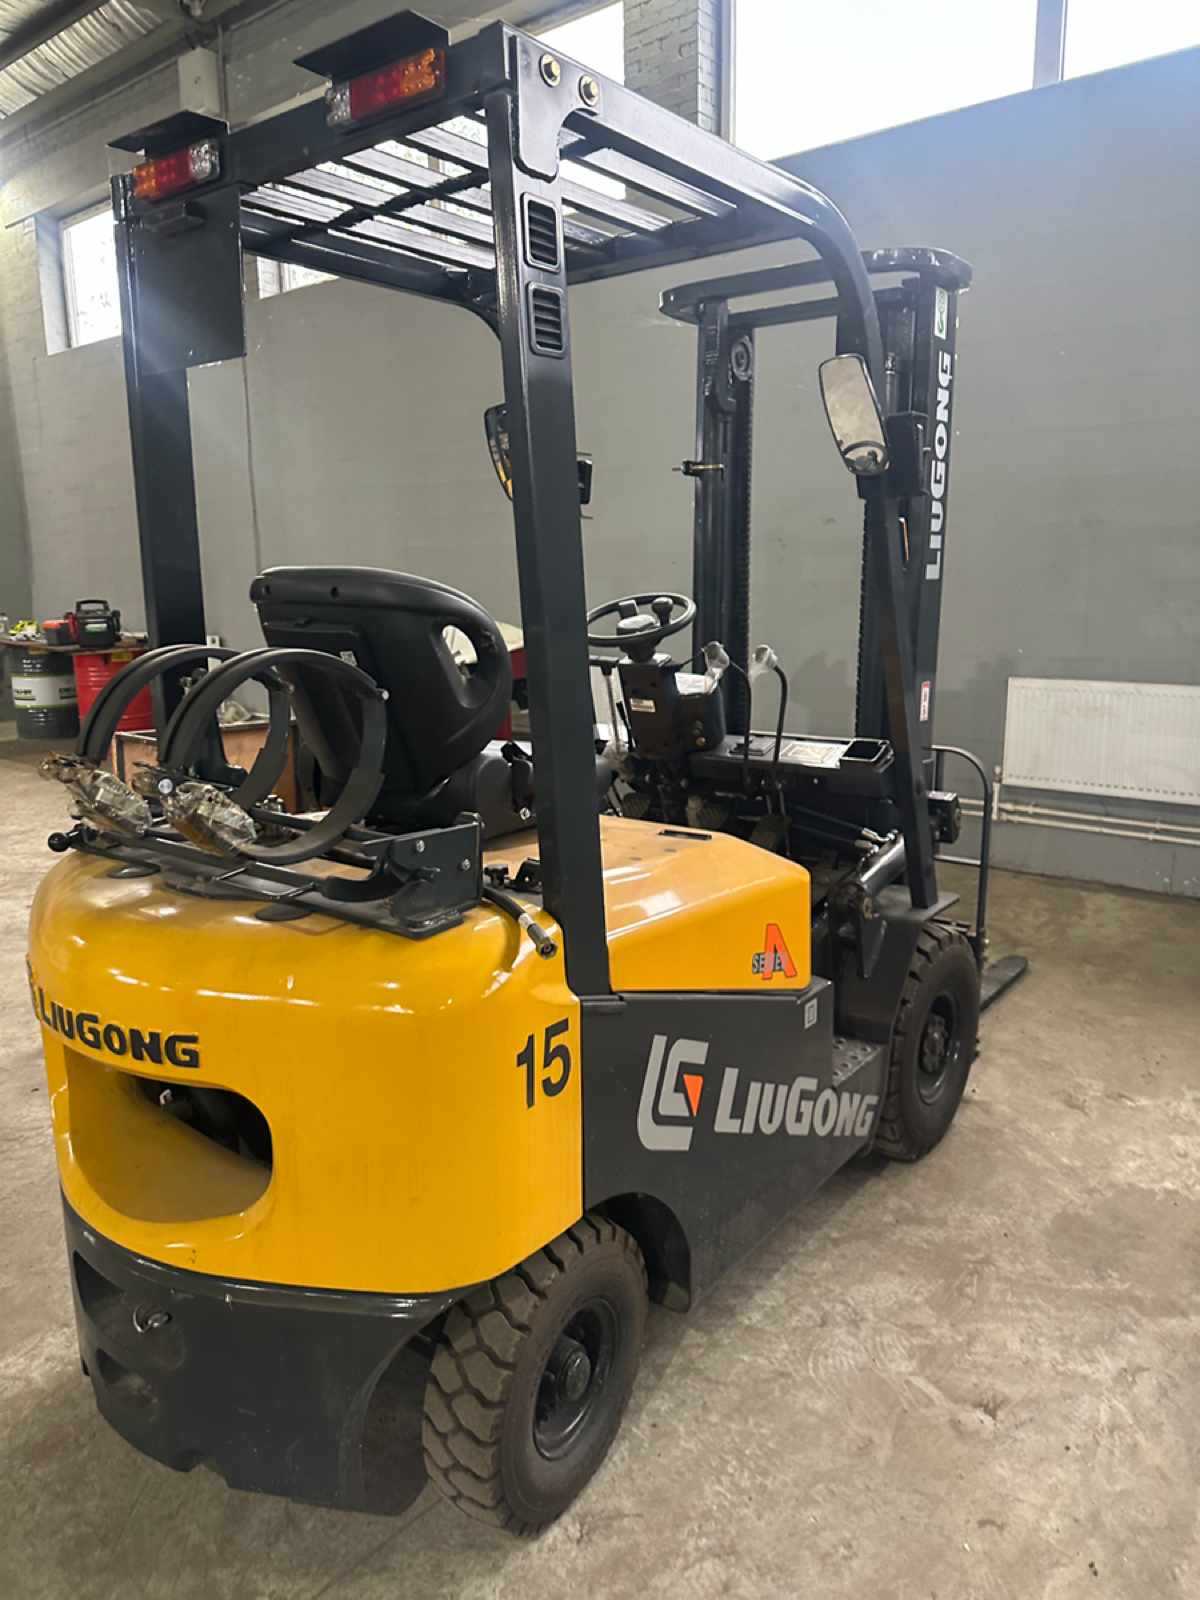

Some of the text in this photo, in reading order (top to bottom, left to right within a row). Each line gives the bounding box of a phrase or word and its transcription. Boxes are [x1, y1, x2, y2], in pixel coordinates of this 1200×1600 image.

[925, 351, 952, 580] LIUGONG
[763, 923, 797, 980] A
[516, 1018, 570, 1109] 15
